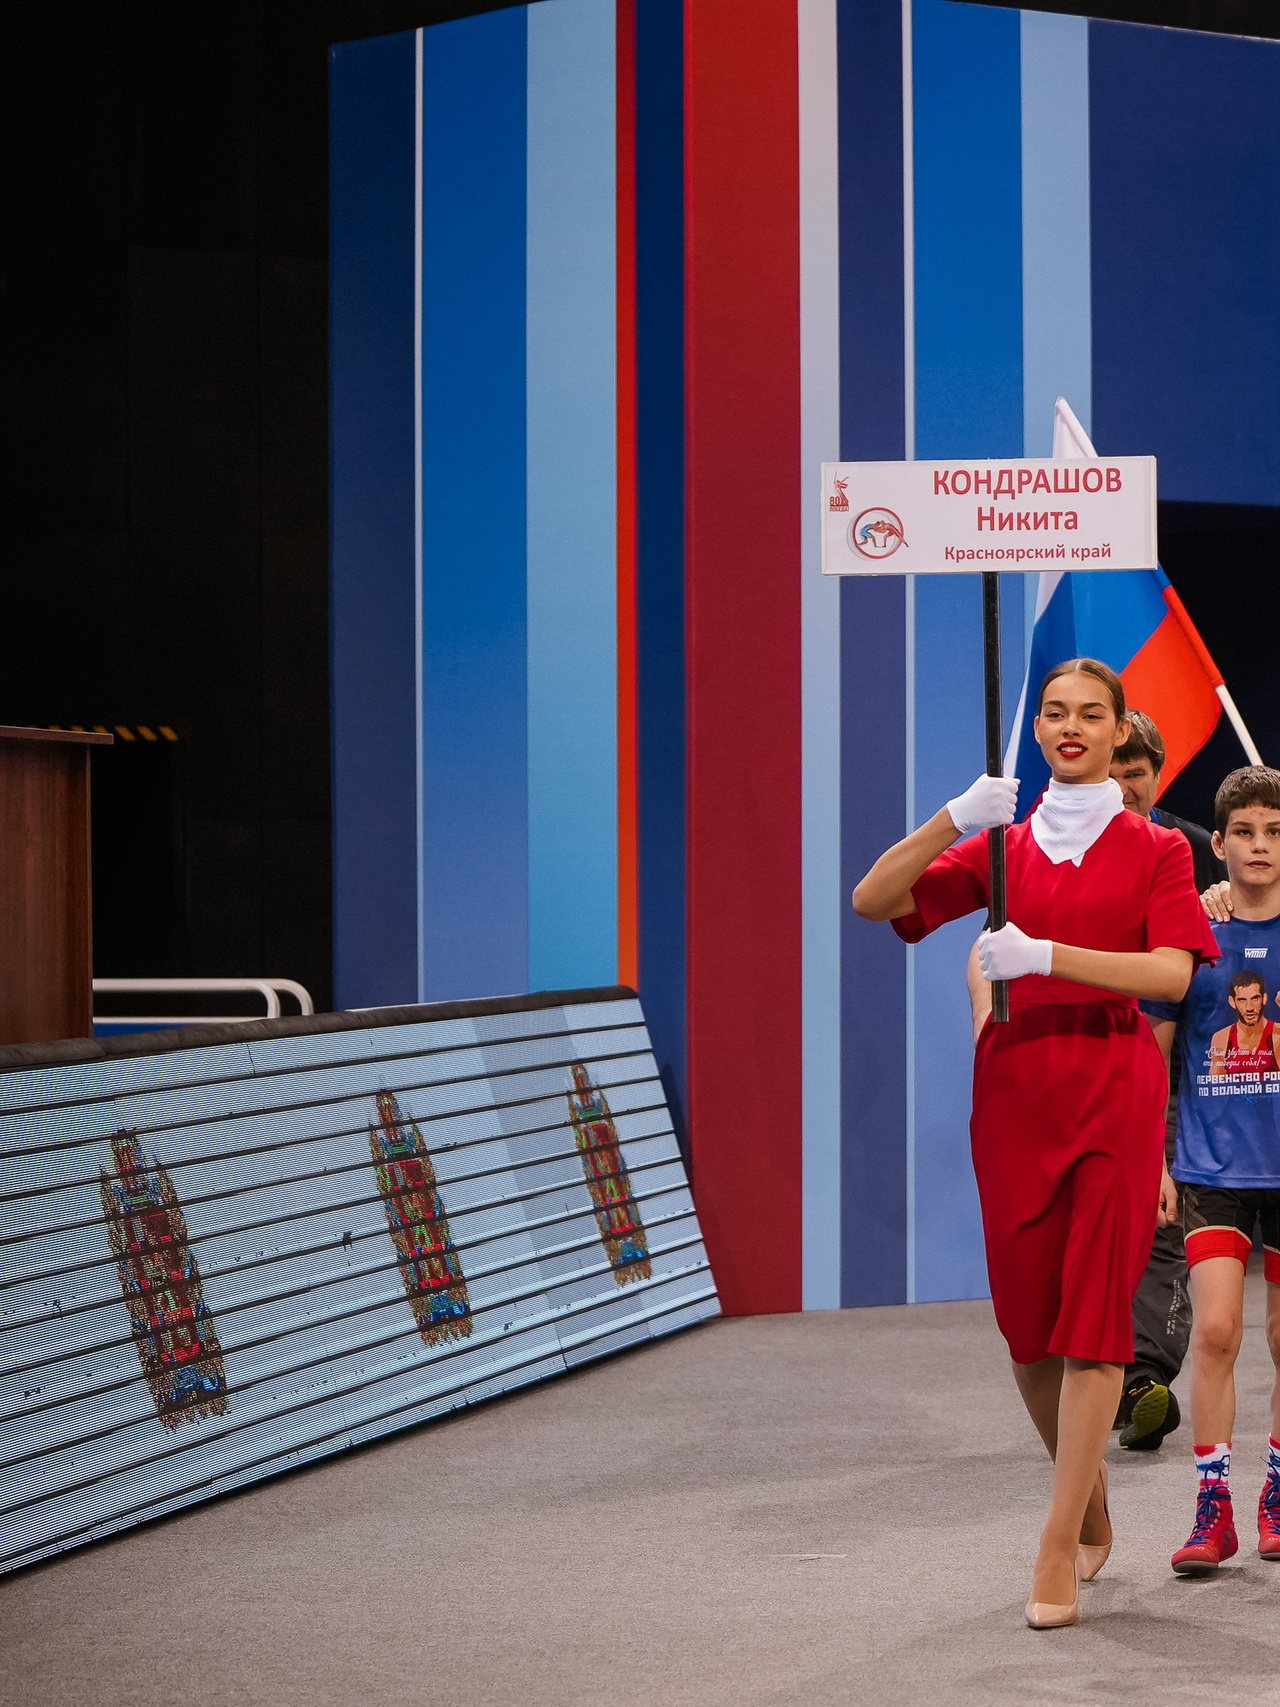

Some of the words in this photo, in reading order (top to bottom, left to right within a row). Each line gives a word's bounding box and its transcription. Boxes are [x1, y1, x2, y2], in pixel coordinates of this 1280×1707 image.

[933, 467, 1122, 499] КОНДРАШОВ
[977, 506, 1078, 531] Никита
[944, 544, 1066, 561] Красноярский
[1071, 543, 1111, 561] край
[1197, 1072, 1261, 1084] ПЕРВЕНСТВО
[1198, 1087, 1209, 1096] ПО
[1212, 1082, 1262, 1096] ВОЛЬНОЙ
